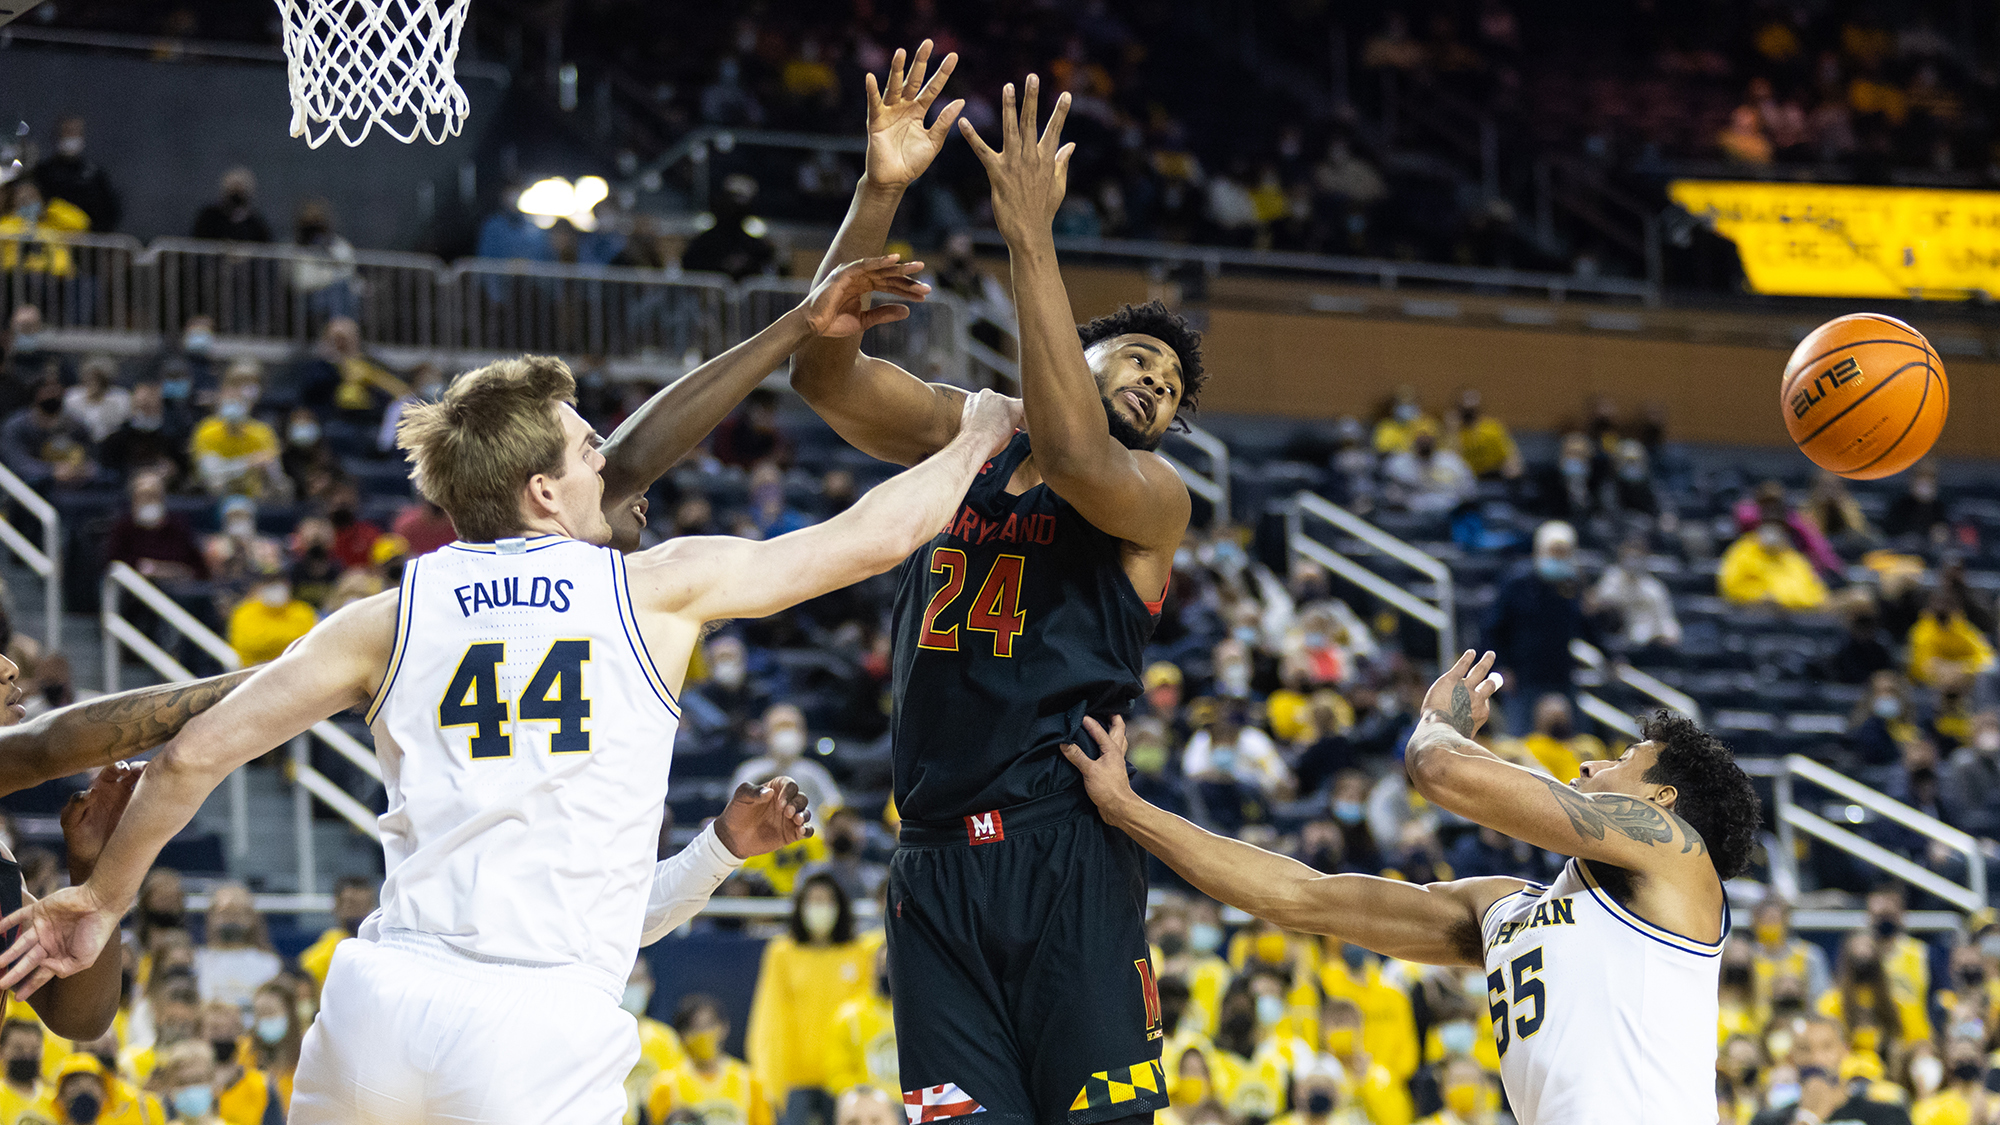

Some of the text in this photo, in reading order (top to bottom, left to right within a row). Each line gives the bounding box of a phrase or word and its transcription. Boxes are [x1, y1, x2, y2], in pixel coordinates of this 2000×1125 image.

[1791, 356, 1862, 420] ELITE
[940, 505, 1056, 545] ARYLAND
[454, 576, 574, 618] FAULDS
[918, 547, 1027, 658] 24
[438, 637, 592, 761] 44
[970, 812, 996, 838] M
[1487, 945, 1546, 1060] 55
